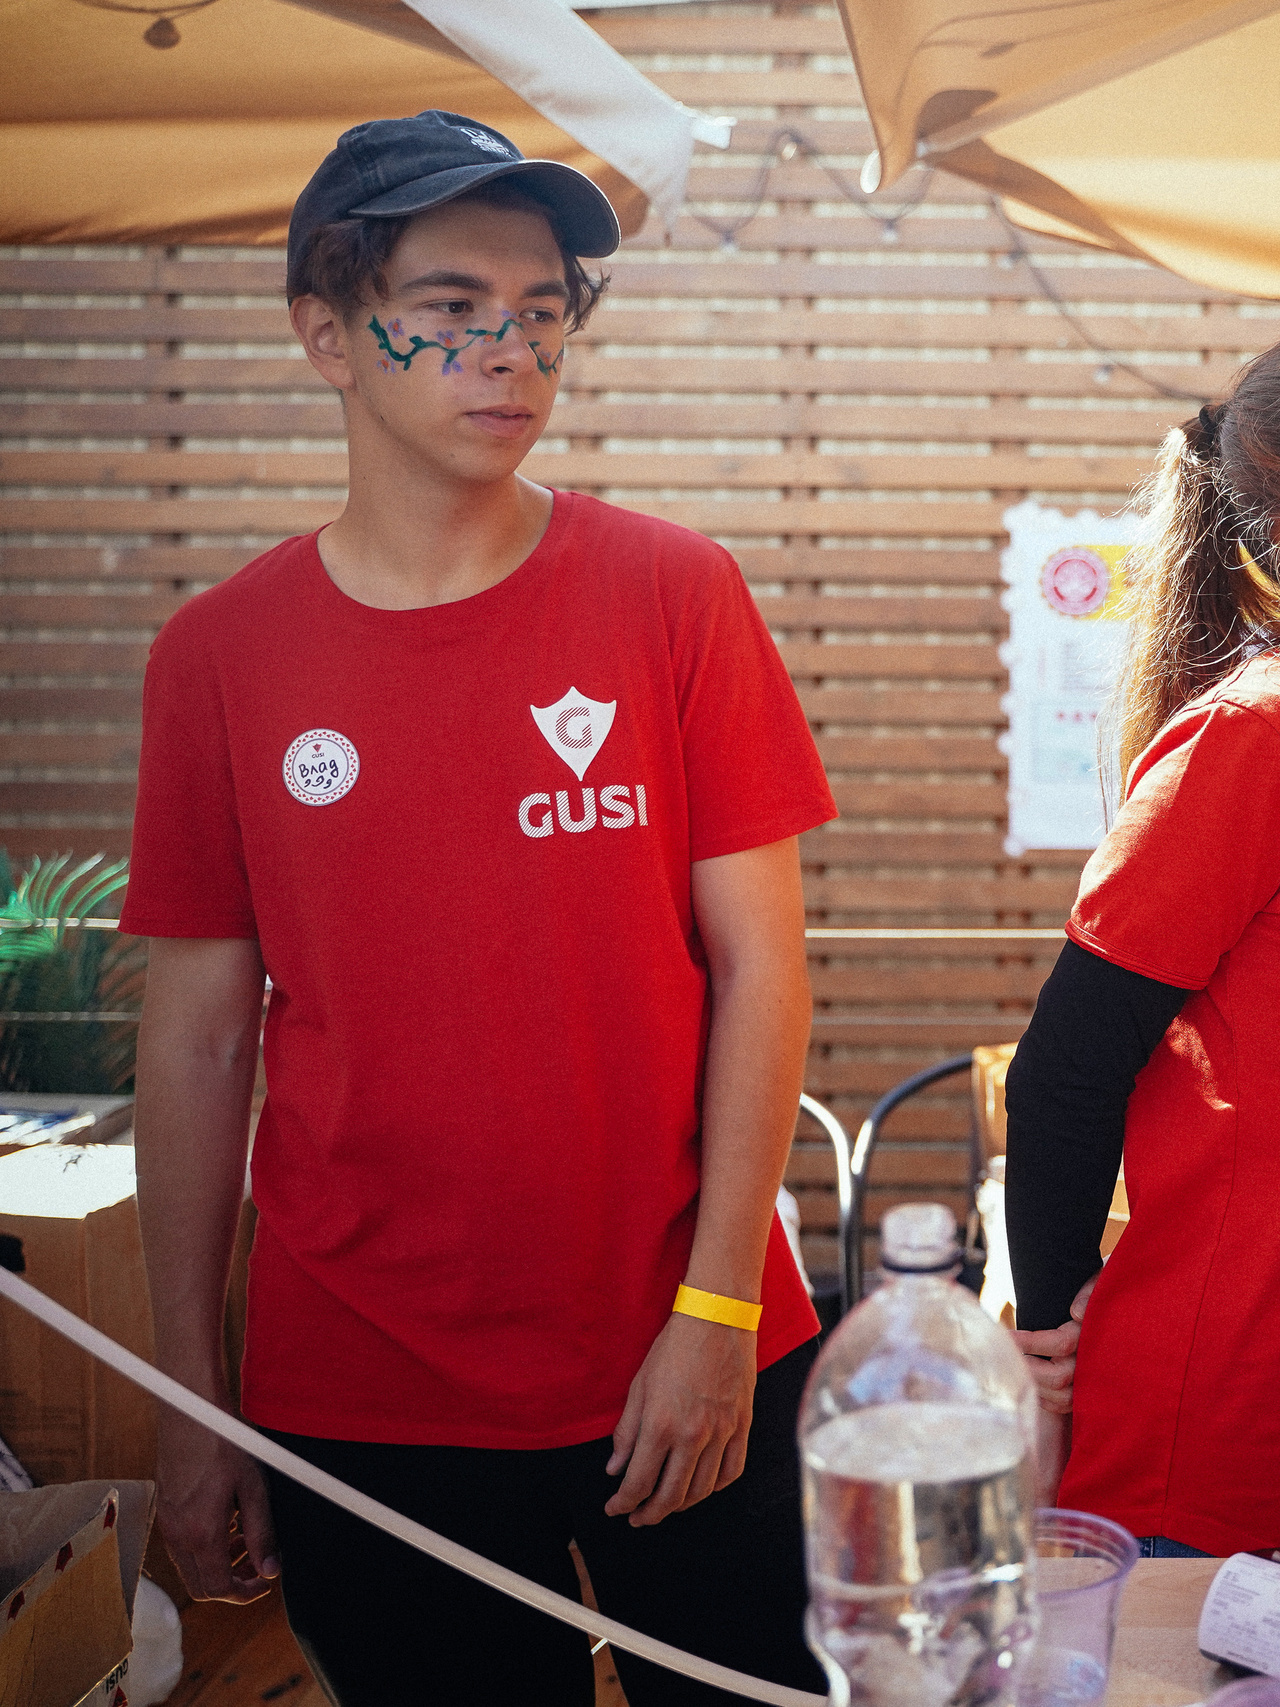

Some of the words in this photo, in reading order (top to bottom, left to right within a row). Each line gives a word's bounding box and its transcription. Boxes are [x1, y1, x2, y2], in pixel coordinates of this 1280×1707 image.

[556, 706, 592, 749] G
[298, 759, 339, 778] Влад
[518, 785, 648, 838] GUSI
